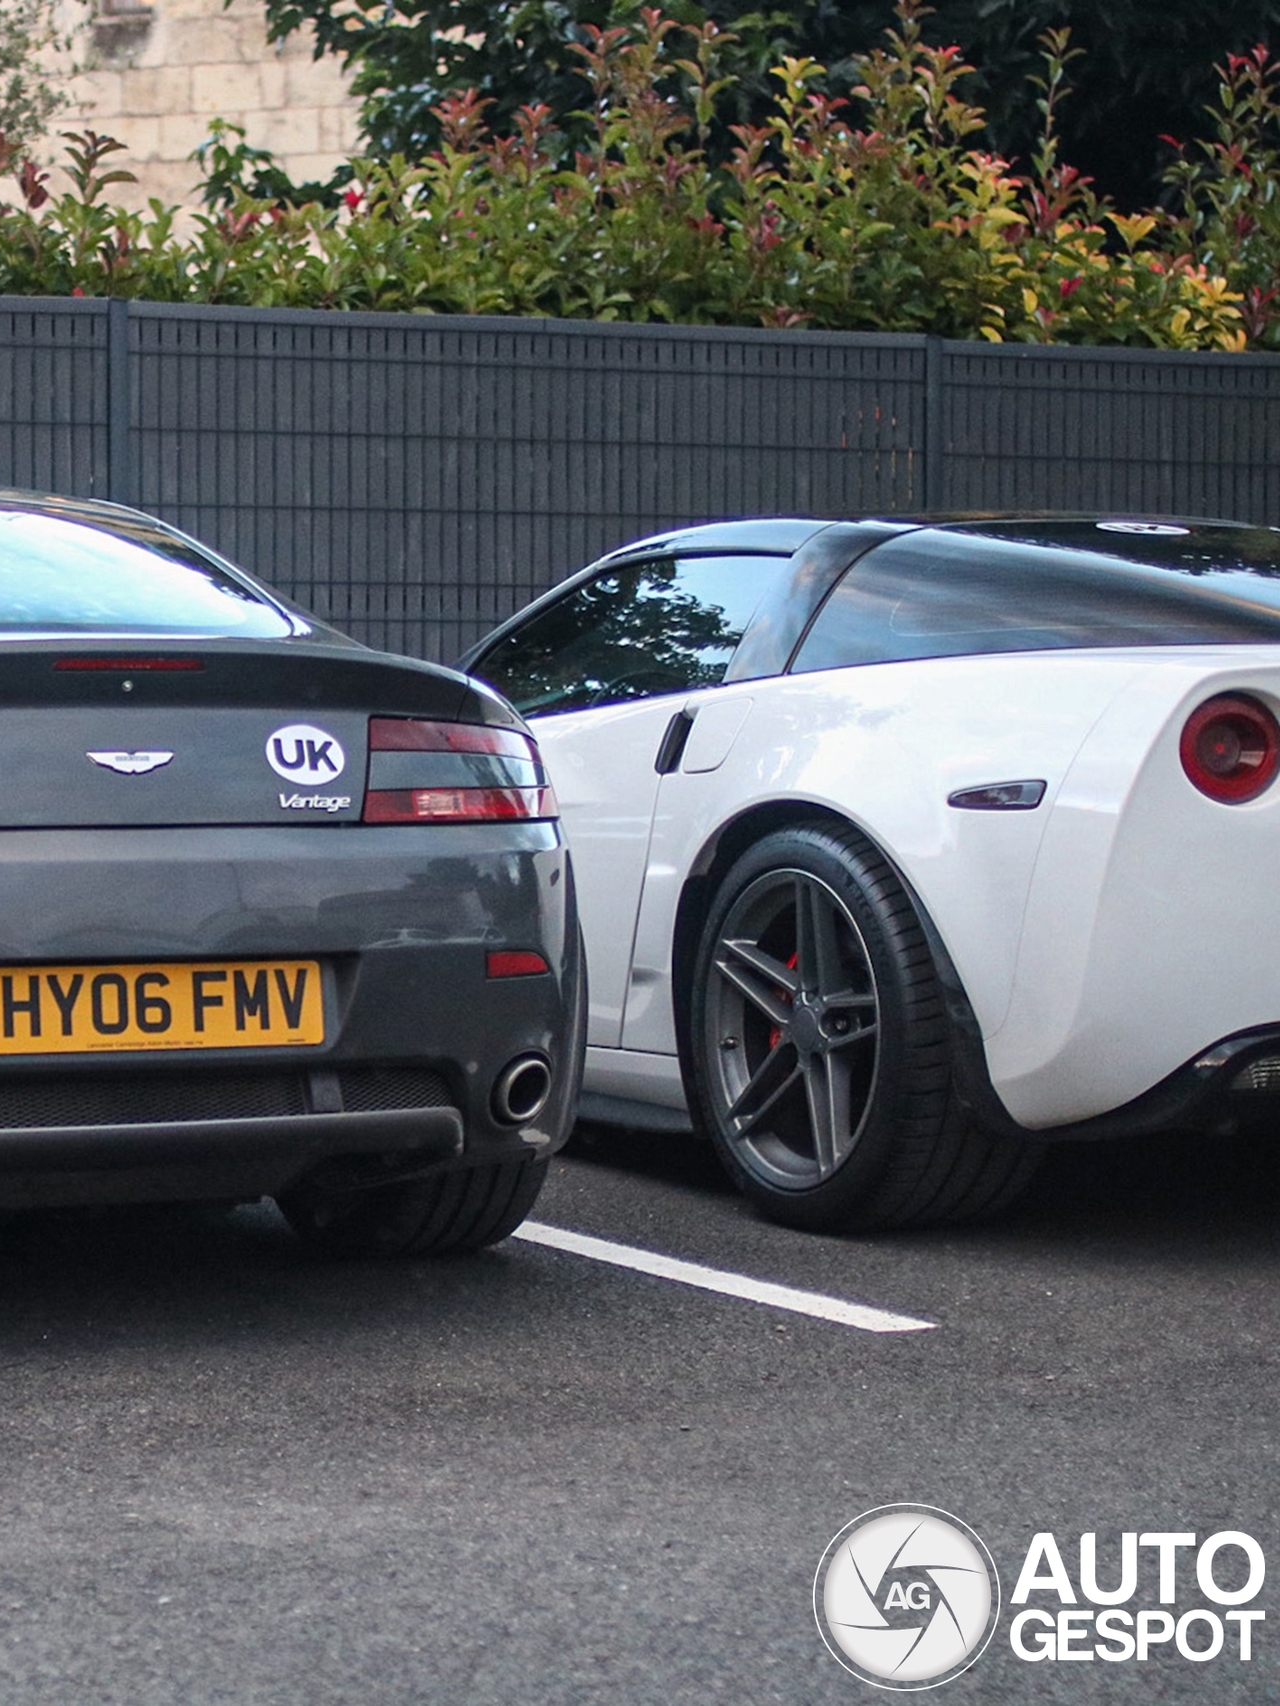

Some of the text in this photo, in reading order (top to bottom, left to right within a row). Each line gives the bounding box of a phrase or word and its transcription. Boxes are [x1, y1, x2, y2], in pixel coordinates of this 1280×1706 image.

[273, 738, 338, 772] UK
[279, 793, 351, 812] Vantage
[1, 968, 308, 1038] HY06 FMV
